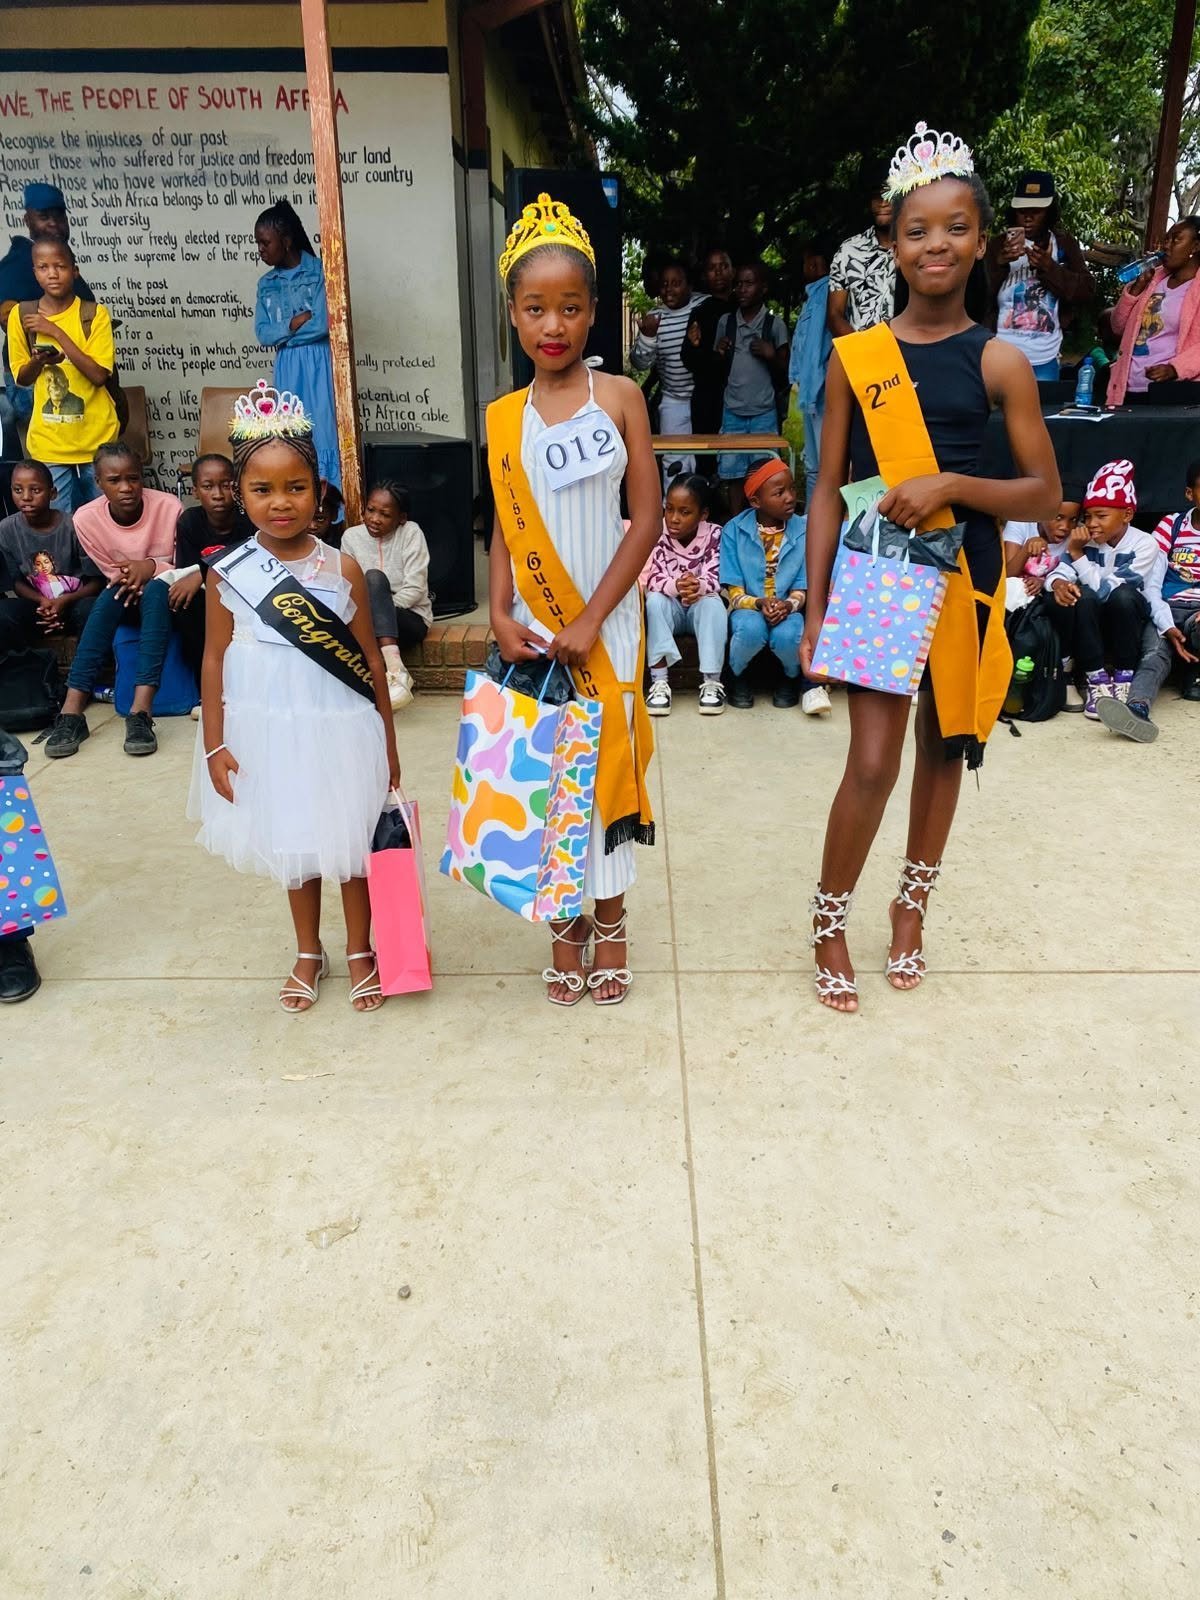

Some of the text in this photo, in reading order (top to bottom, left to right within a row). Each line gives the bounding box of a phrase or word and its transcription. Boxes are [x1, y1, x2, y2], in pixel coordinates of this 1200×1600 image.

[0, 85, 349, 118] WE, THE PEOPLE OF SOUTH AFRA
[61, 130, 80, 148] the
[85, 130, 142, 152] injustices
[152, 126, 165, 146] of
[170, 132, 192, 146] our
[200, 130, 228, 152] past
[49, 152, 81, 169] those
[90, 151, 116, 168] who
[124, 149, 173, 167] suffered
[178, 148, 195, 166] for
[198, 151, 235, 171] justice
[239, 149, 260, 165] and
[266, 145, 314, 166] freedom
[363, 145, 391, 164] land
[52, 172, 87, 191] those
[93, 174, 119, 190] who
[123, 172, 155, 189] have
[161, 171, 206, 189] worked
[214, 170, 228, 188] to
[231, 169, 259, 188] build
[265, 169, 288, 185] and
[341, 171, 359, 184] our
[365, 164, 413, 187] country
[66, 195, 88, 209] that
[91, 191, 122, 208] South
[125, 190, 158, 208] Africa
[162, 190, 203, 211] belongs
[206, 189, 219, 205] to
[224, 189, 237, 206] all
[241, 190, 266, 205] who
[292, 190, 303, 205] in
[69, 215, 88, 227] our
[100, 211, 150, 231] diversity
[81, 231, 122, 249] through
[127, 235, 143, 245] our
[149, 231, 178, 250] freely
[184, 229, 220, 245] elected
[97, 254, 109, 263] as
[112, 249, 128, 263] the
[134, 252, 176, 268] supreme
[181, 246, 200, 261] law
[206, 246, 216, 261] of
[222, 247, 238, 261] the
[111, 276, 120, 290] of
[126, 277, 142, 290] the
[146, 278, 168, 295] past
[99, 290, 242, 309] society based on democratic,
[113, 304, 254, 322] fundamental human rights
[125, 325, 141, 340] for
[146, 330, 153, 340] a
[115, 346, 139, 360] open
[144, 344, 184, 359] society
[190, 343, 201, 356] in
[206, 341, 237, 356] which
[116, 359, 136, 371] will
[141, 357, 151, 370] of
[157, 358, 177, 371] the
[182, 357, 216, 377] people
[220, 356, 242, 369] and
[382, 355, 436, 374] protected
[160, 391, 171, 405] of
[180, 389, 198, 405] life
[415, 388, 430, 404] of
[866, 373, 900, 410] 2nd
[165, 411, 174, 420] a
[376, 403, 416, 421] Africa
[421, 407, 450, 423] able
[168, 431, 176, 439] a
[546, 429, 616, 471] 012
[501, 452, 525, 530] Miss
